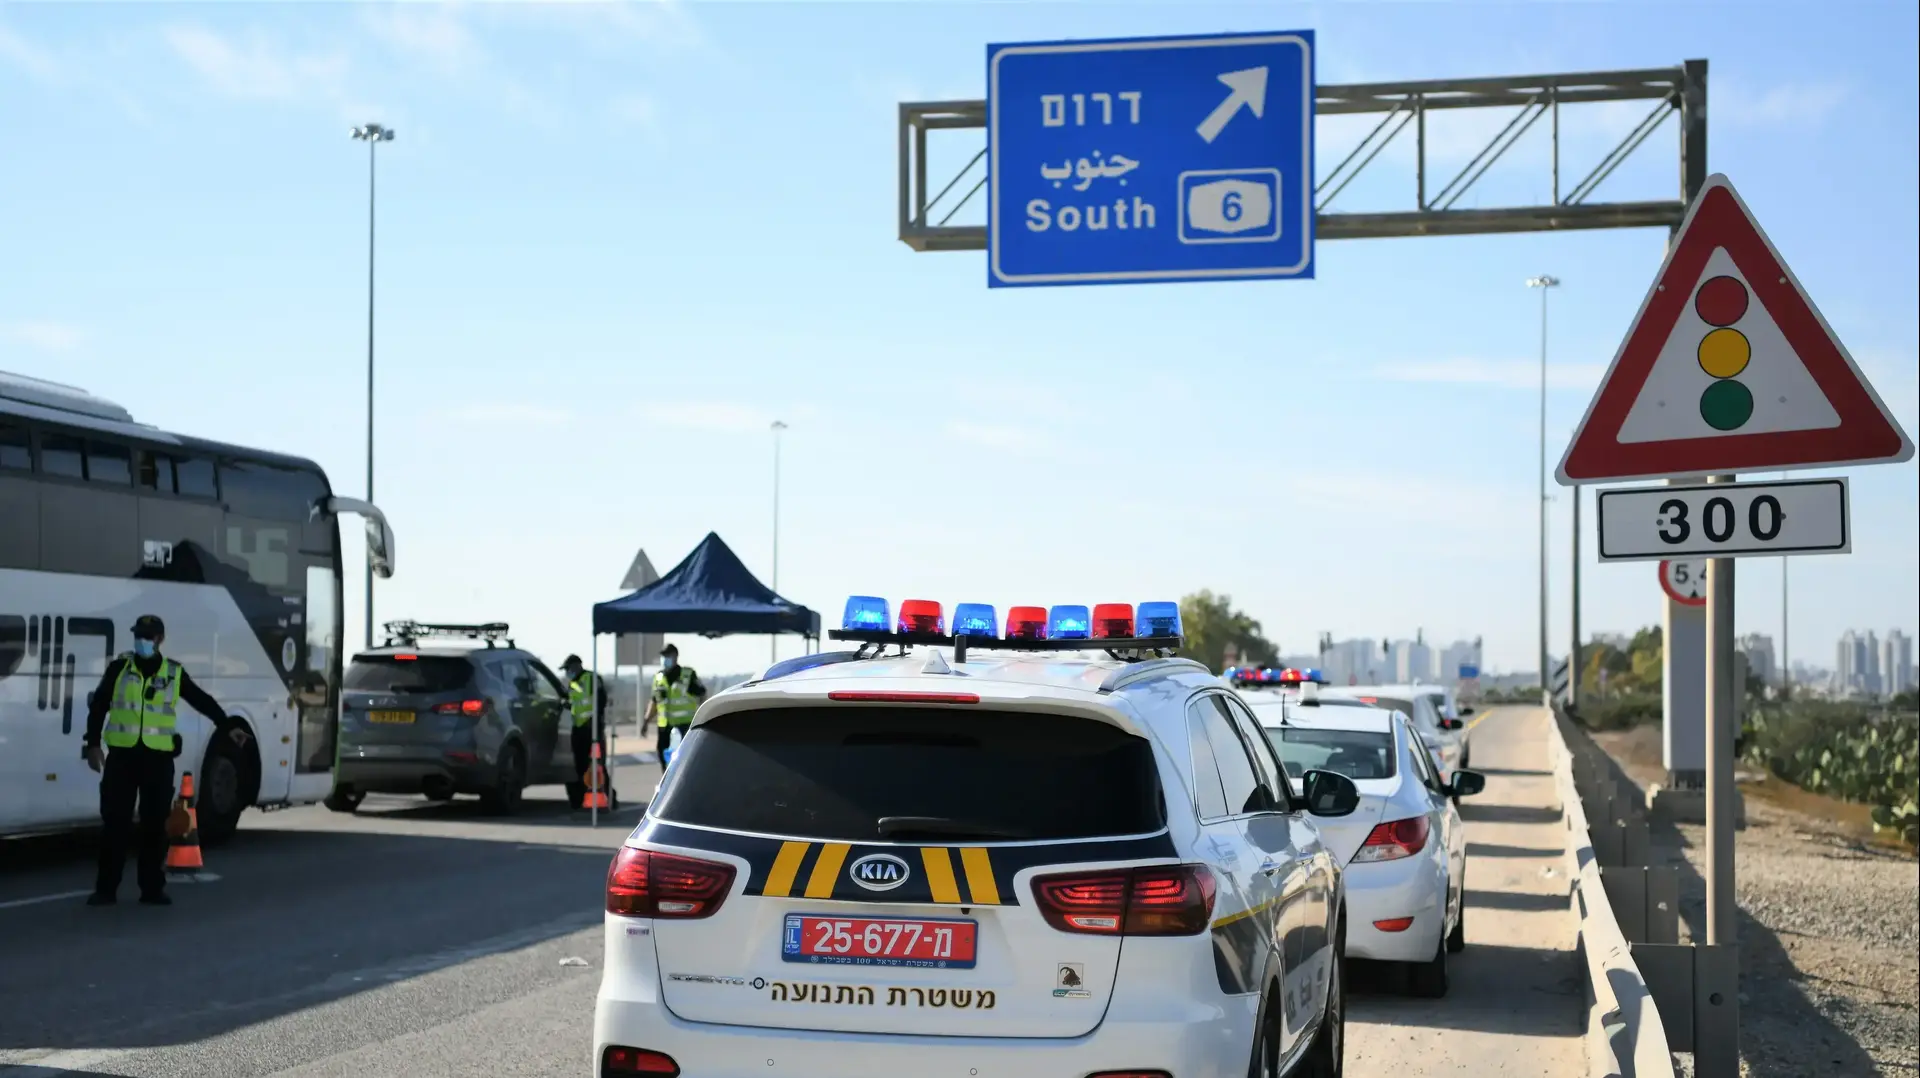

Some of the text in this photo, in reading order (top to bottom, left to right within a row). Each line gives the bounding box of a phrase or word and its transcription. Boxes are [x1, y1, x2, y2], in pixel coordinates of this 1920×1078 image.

[1040, 91, 1142, 127] דרום
[1040, 149, 1140, 192] جنوب
[1025, 197, 1156, 233] South
[1221, 191, 1244, 223] 6
[1658, 494, 1783, 545] 300
[861, 863, 898, 880] KIA
[786, 928, 798, 944] IL
[770, 981, 997, 1009] משטרת התנועה
